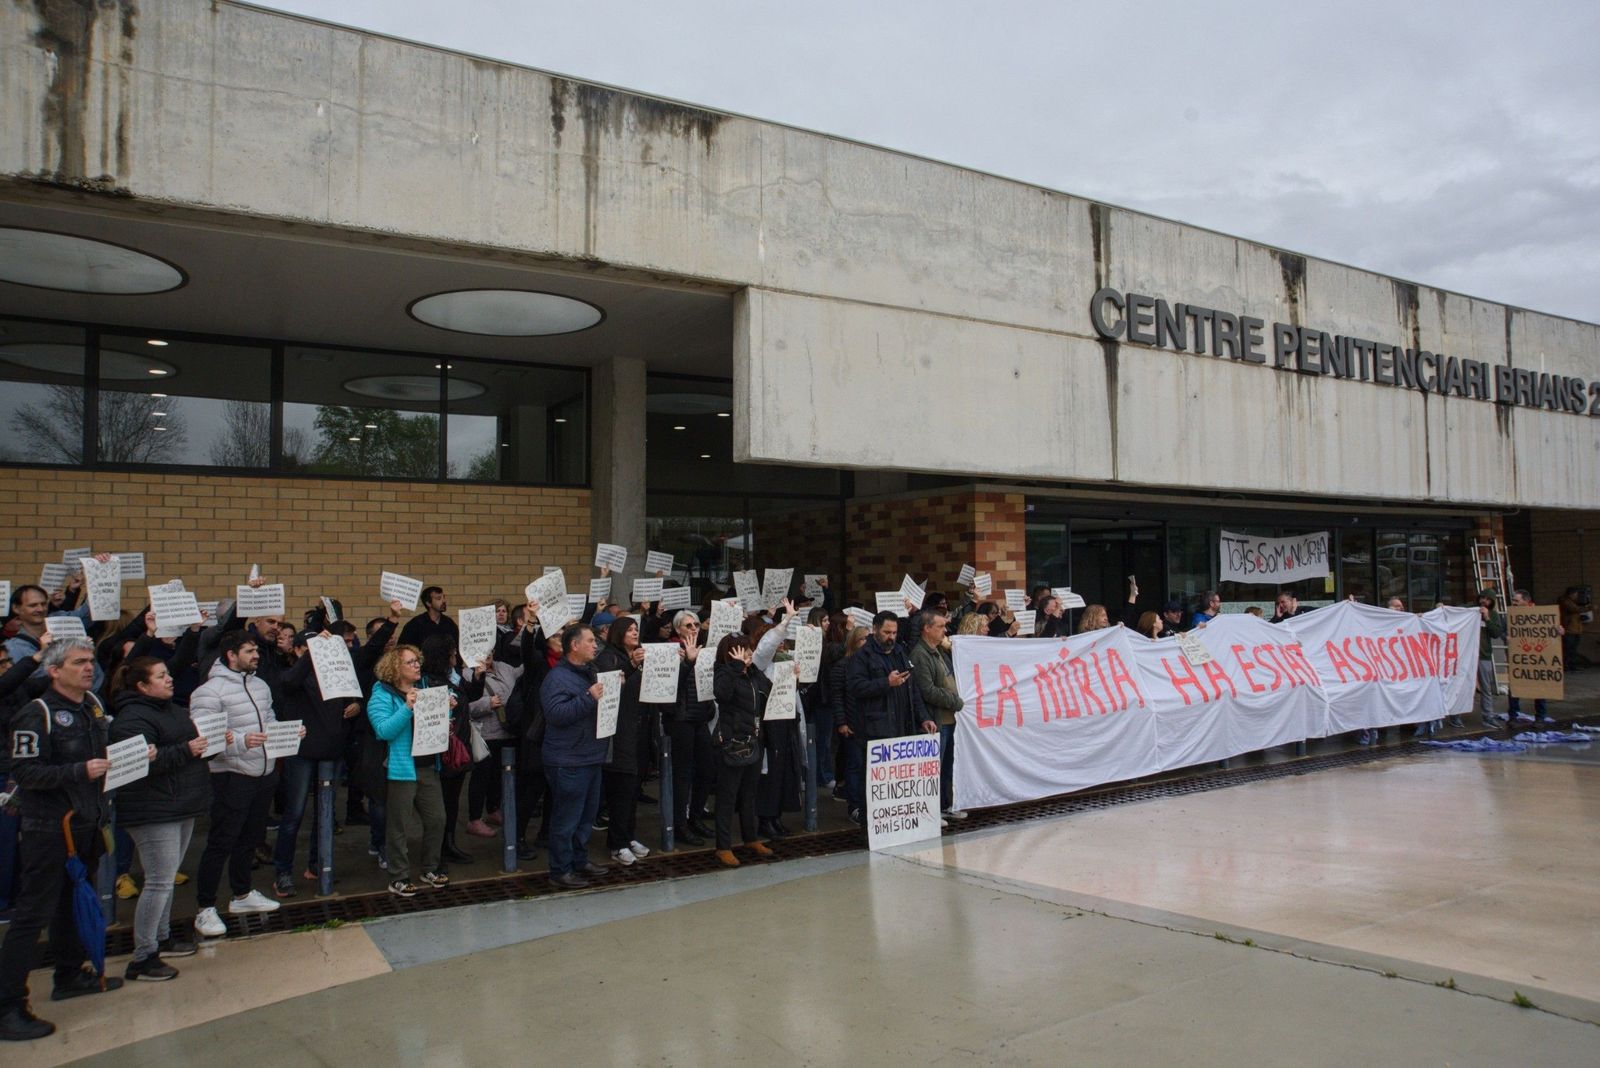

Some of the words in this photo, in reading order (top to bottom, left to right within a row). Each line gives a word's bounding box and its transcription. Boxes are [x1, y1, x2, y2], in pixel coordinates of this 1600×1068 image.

[1091, 287, 1266, 364] CENTRE
[1273, 322, 1491, 400] PENITENCIARI
[1495, 364, 1588, 415] BRIANS
[1510, 614, 1556, 626] UBASART
[1512, 653, 1546, 666] CESA
[1551, 655, 1561, 666] A
[973, 663, 1024, 728] LA
[1160, 654, 1237, 705] HA
[871, 743, 891, 764] SIN
[893, 738, 940, 760] SEGURIDAD
[871, 766, 886, 781] NO
[889, 763, 916, 780] PUEDE
[918, 760, 940, 778] HABER
[872, 777, 938, 802] REINSERCIÓN
[872, 801, 928, 820] CONSEJERA
[875, 817, 919, 835] DIMISION
